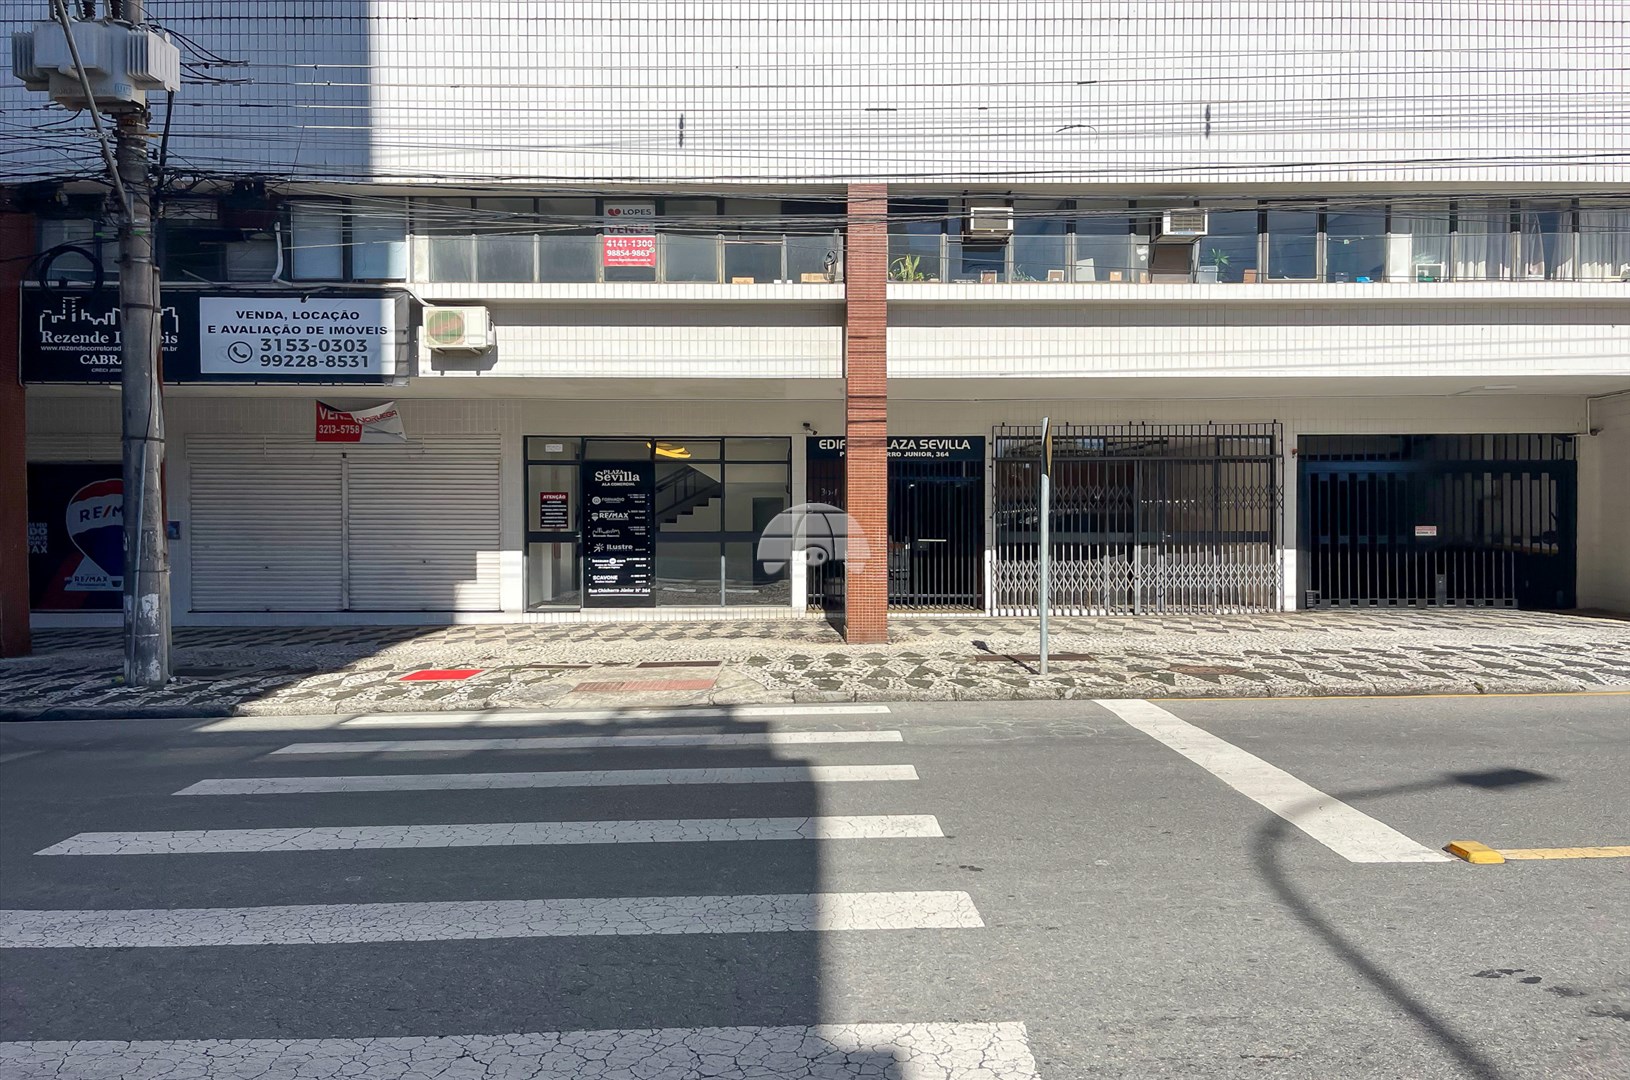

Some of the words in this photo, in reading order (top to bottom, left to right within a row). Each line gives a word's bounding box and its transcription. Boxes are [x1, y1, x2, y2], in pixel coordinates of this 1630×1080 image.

[622, 208, 652, 216] LOPES
[606, 240, 653, 248] 4141-1300
[606, 249, 650, 257] 98854-9863
[235, 310, 288, 321] VENDA,
[293, 309, 360, 322] LOCAÇÃO
[207, 325, 216, 334] E
[221, 323, 302, 336] AVALIAÇÃO
[306, 326, 324, 335] DE
[329, 323, 389, 335] IMÓVEIS
[41, 330, 110, 344] Rezende
[260, 338, 369, 353] 3153-0303
[260, 354, 369, 369] 99228-8531
[319, 424, 361, 434] 3213-5758
[919, 439, 971, 450] SEVILLA
[594, 470, 641, 482] Sevilla
